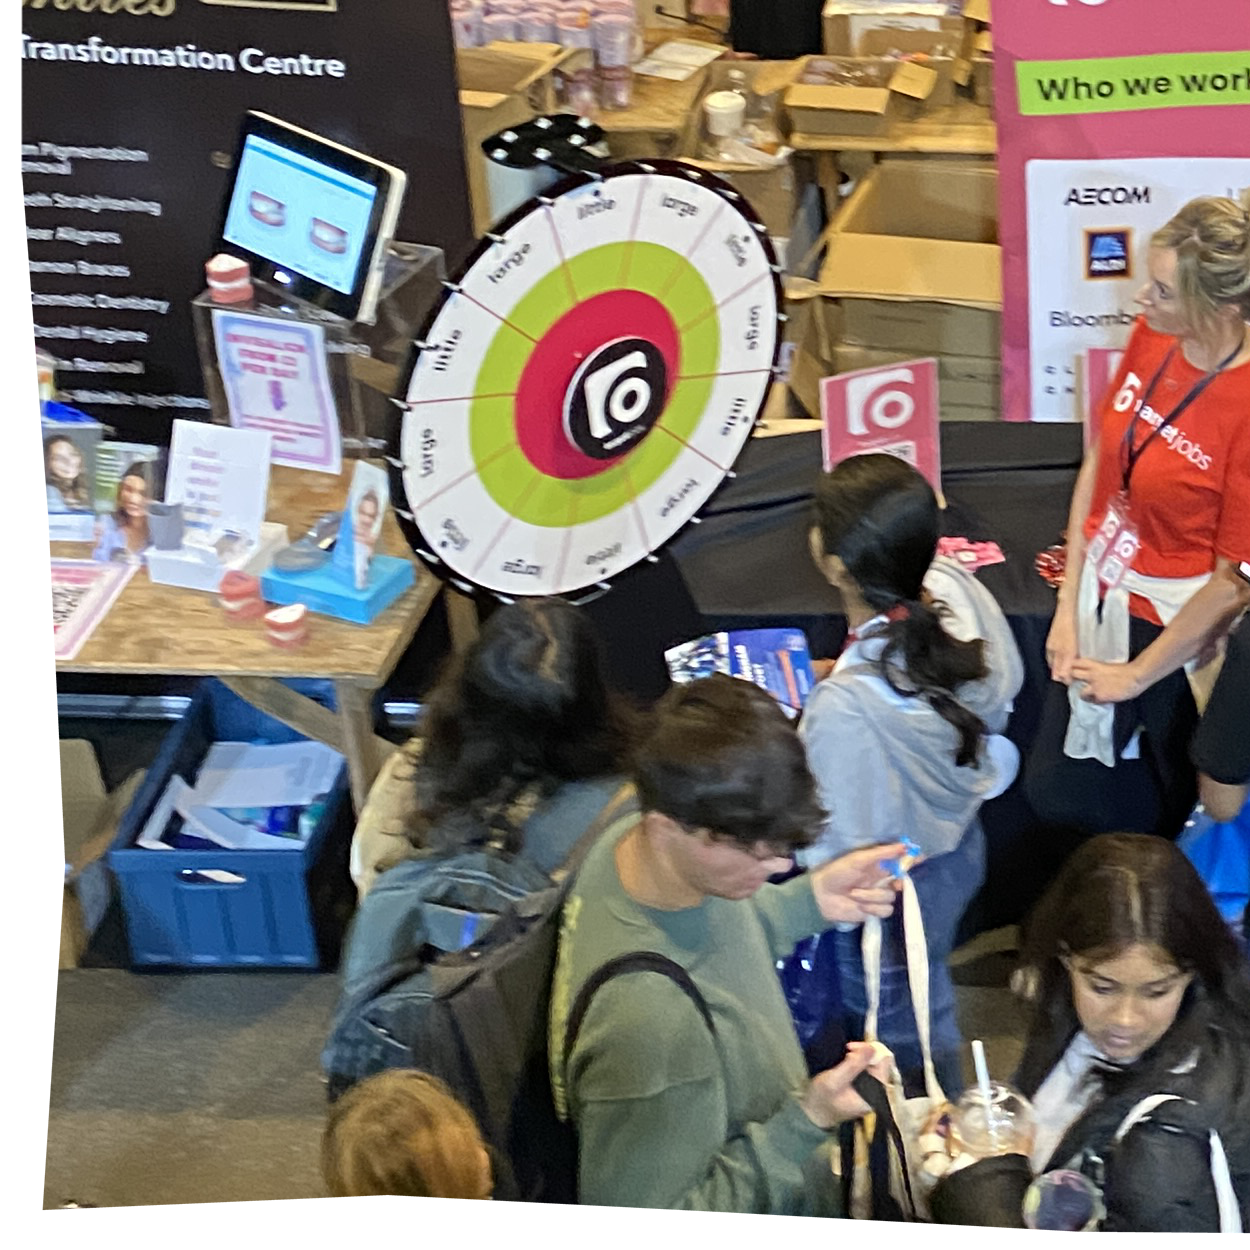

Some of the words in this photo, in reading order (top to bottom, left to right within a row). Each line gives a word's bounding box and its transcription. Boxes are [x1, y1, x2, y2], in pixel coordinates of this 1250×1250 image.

[238, 47, 346, 79] Centre
[1036, 75, 1114, 104] Who
[1124, 72, 1171, 96] we
[577, 195, 617, 221] little
[662, 195, 700, 218] large
[1064, 187, 1151, 206] AECOM
[487, 242, 533, 285] large
[743, 304, 763, 352] large
[1050, 309, 1135, 328] Bloomb
[432, 327, 463, 372] little
[718, 396, 749, 440] little
[416, 427, 439, 479] large
[658, 477, 701, 520] large
[501, 559, 544, 578] large
